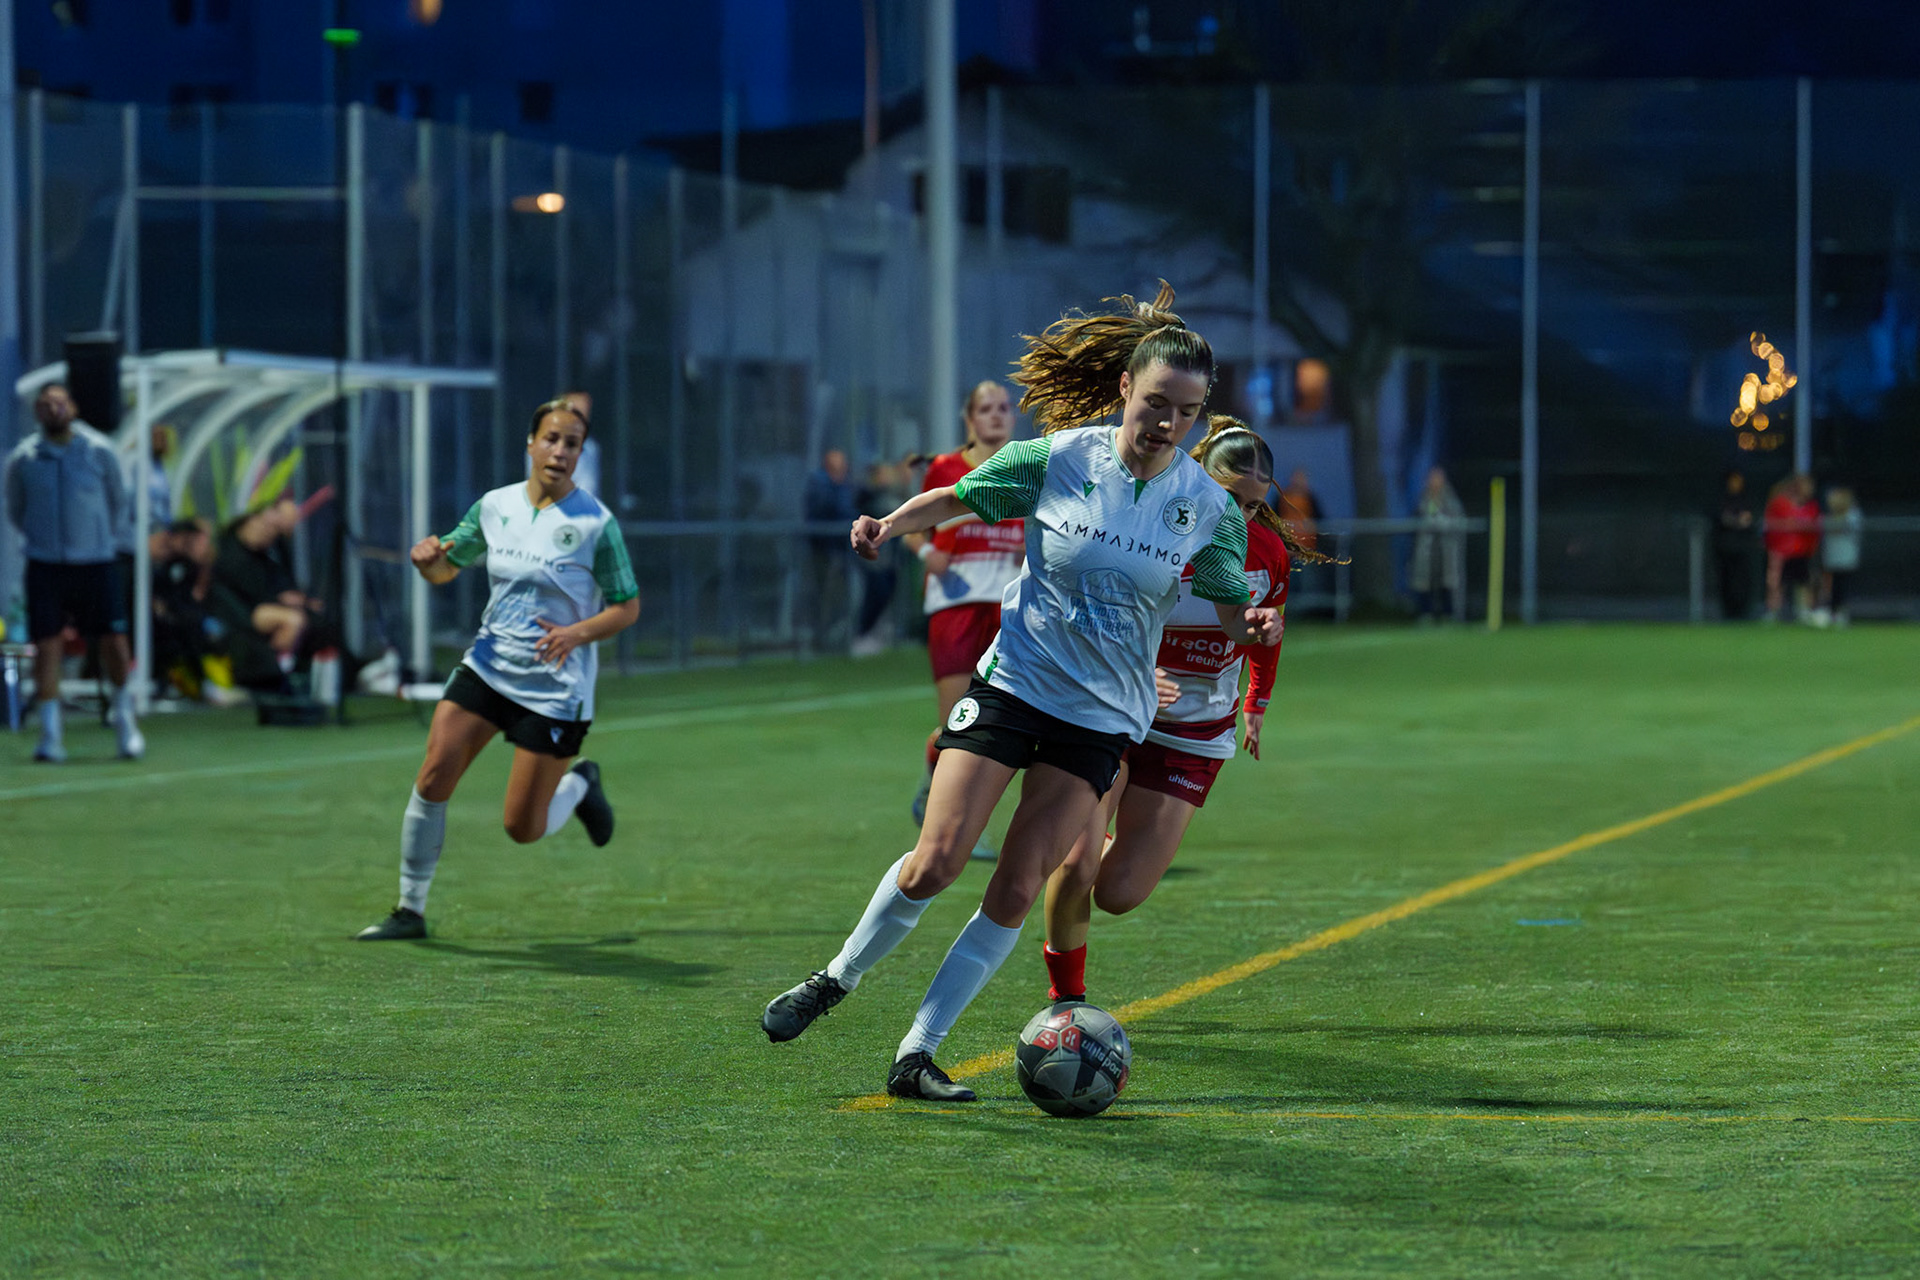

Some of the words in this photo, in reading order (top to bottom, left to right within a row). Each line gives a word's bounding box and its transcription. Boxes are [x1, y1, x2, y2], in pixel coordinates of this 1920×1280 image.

[1186, 652, 1235, 669] treuhand
[1168, 774, 1206, 793] uhlsport
[1081, 1040, 1122, 1079] uhlsport
